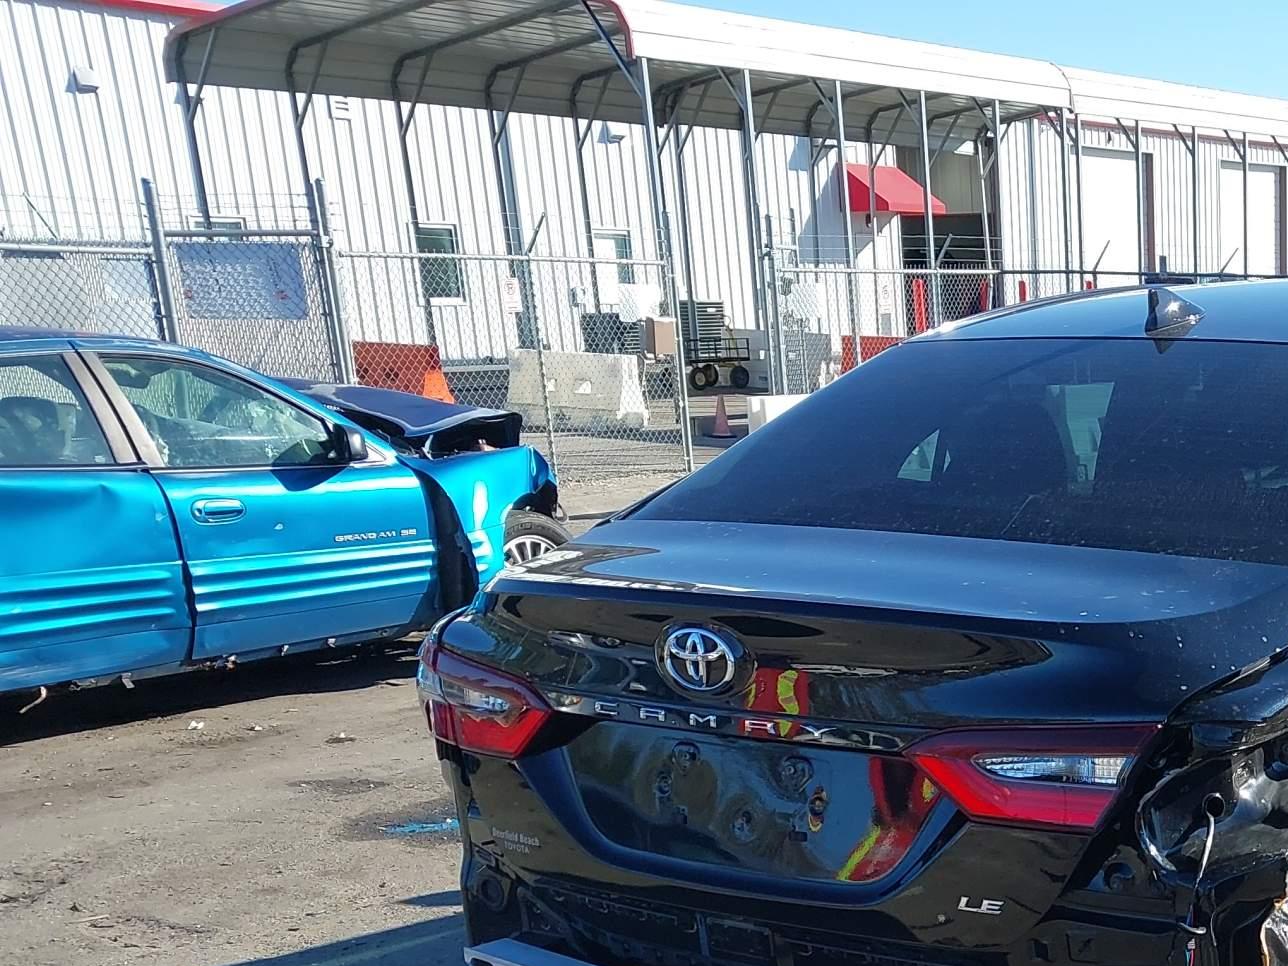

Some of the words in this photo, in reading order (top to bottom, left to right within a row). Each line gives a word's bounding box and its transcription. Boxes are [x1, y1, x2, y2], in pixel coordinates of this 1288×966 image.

[334, 532, 377, 542] GRAND
[378, 530, 396, 538] AM
[594, 701, 837, 737] CAMRY
[504, 840, 530, 854] TOYOTA
[958, 896, 1004, 915] LE
